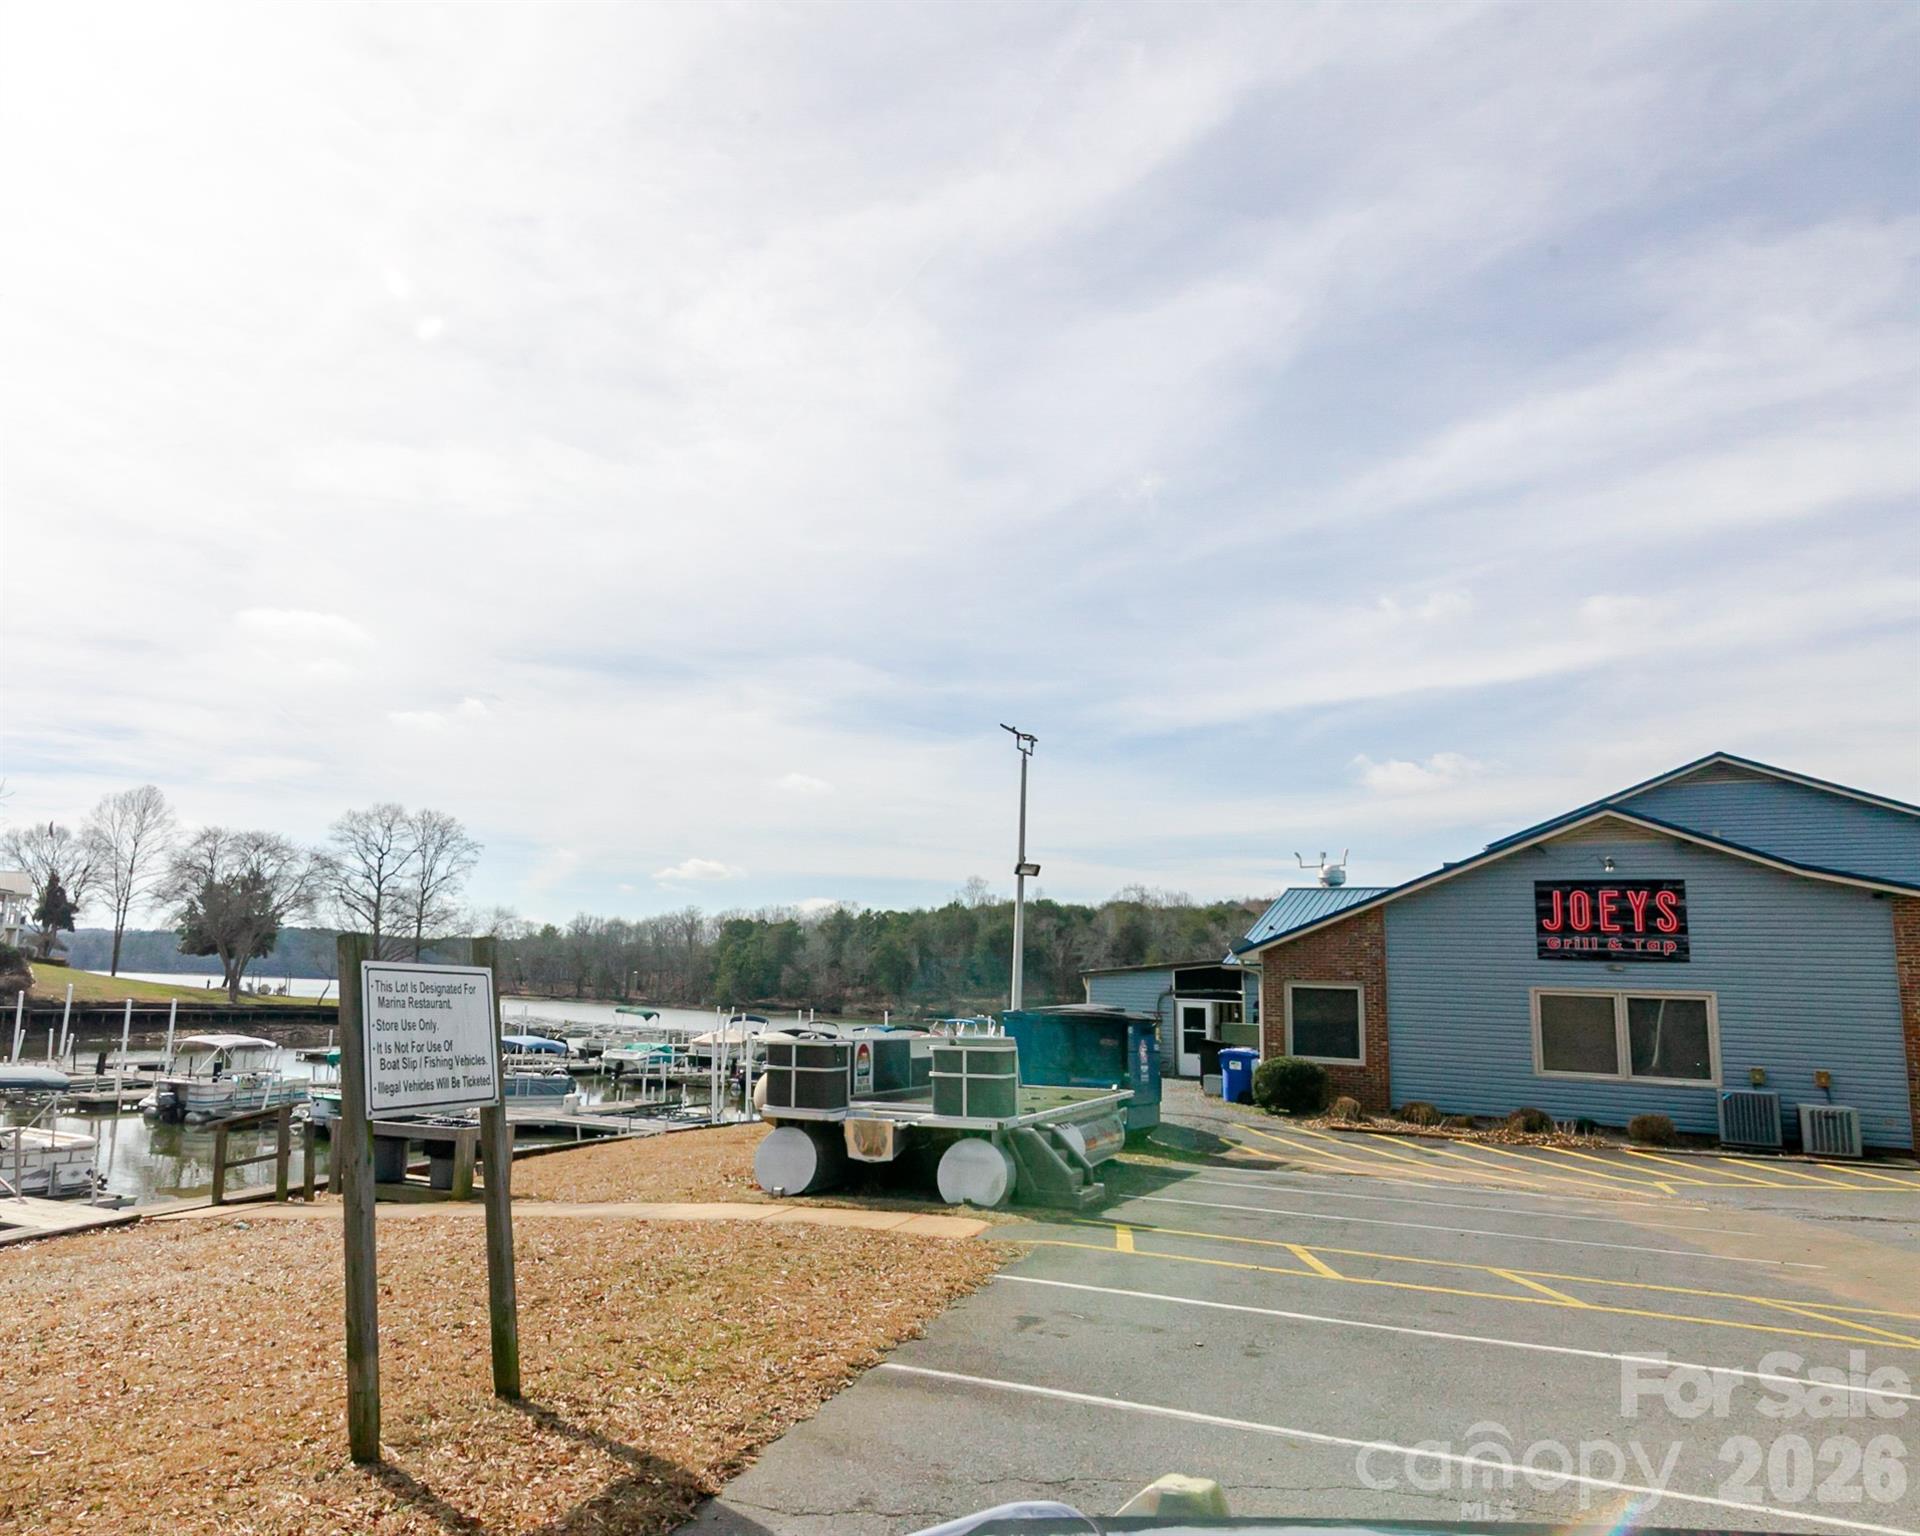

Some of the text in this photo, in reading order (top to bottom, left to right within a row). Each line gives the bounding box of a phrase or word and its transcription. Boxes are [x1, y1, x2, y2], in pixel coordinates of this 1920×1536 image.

[1542, 889, 1680, 933] JOEYS
[1547, 936, 1678, 956] Grill & Tap
[375, 980, 476, 997] This Lot Is Designated For
[378, 996, 406, 1009] Marina
[376, 1018, 439, 1034] Store Use Only.
[377, 1040, 453, 1054] It Is Not For Use Of
[380, 1058, 400, 1071] Boat
[402, 1056, 418, 1072] Slip
[424, 1055, 453, 1070] Fishing
[455, 1054, 488, 1067] Vehicles.
[378, 1080, 401, 1097] Illegal
[403, 1079, 434, 1092] Vehicles
[436, 1077, 450, 1090] Will
[452, 1076, 461, 1088] Be
